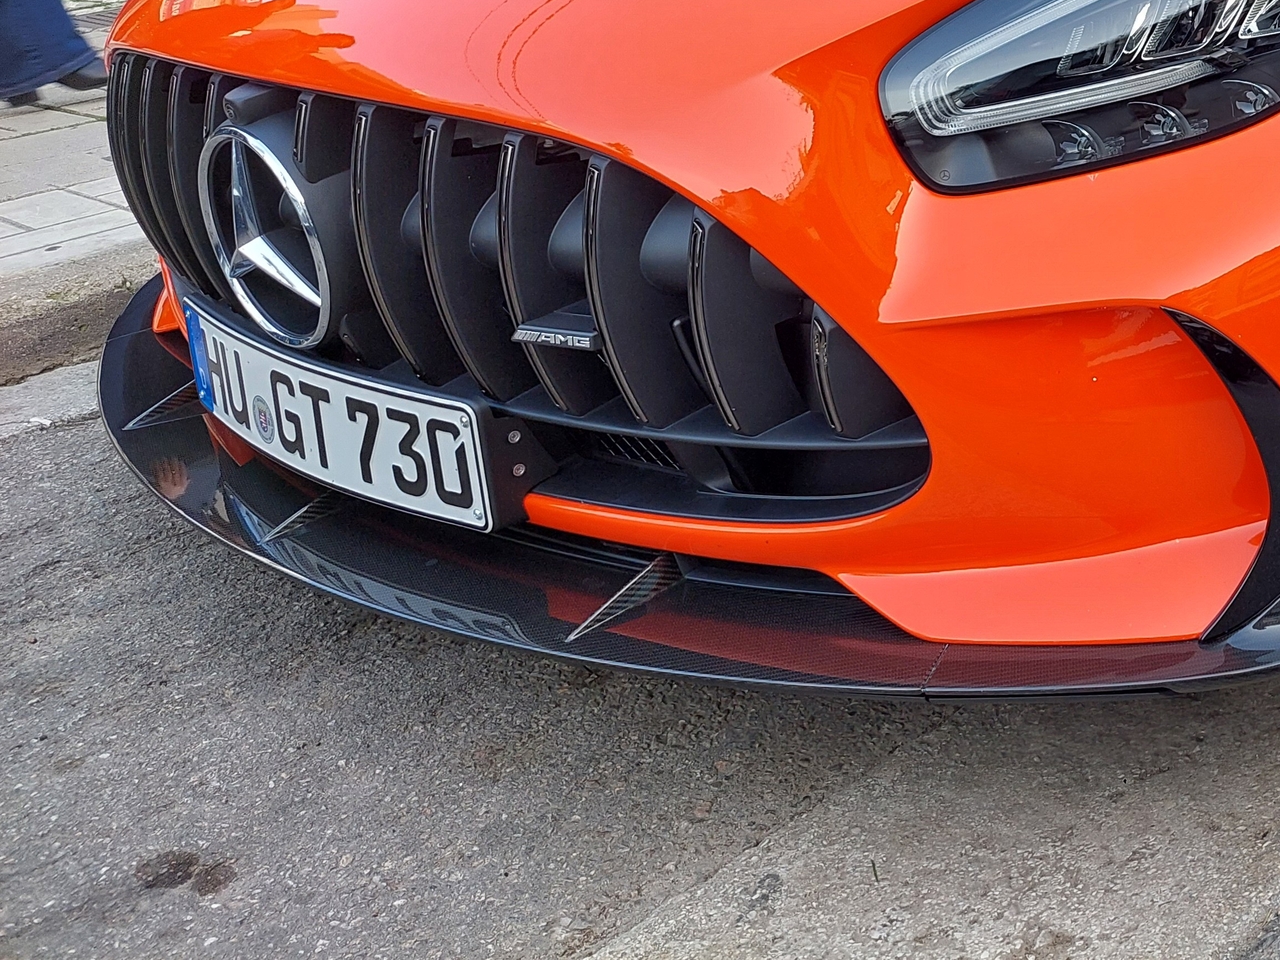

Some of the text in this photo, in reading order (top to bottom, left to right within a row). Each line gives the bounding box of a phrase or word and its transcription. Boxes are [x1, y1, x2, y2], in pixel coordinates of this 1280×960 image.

[537, 332, 591, 349] AMG
[200, 327, 474, 509] HU GT 730
